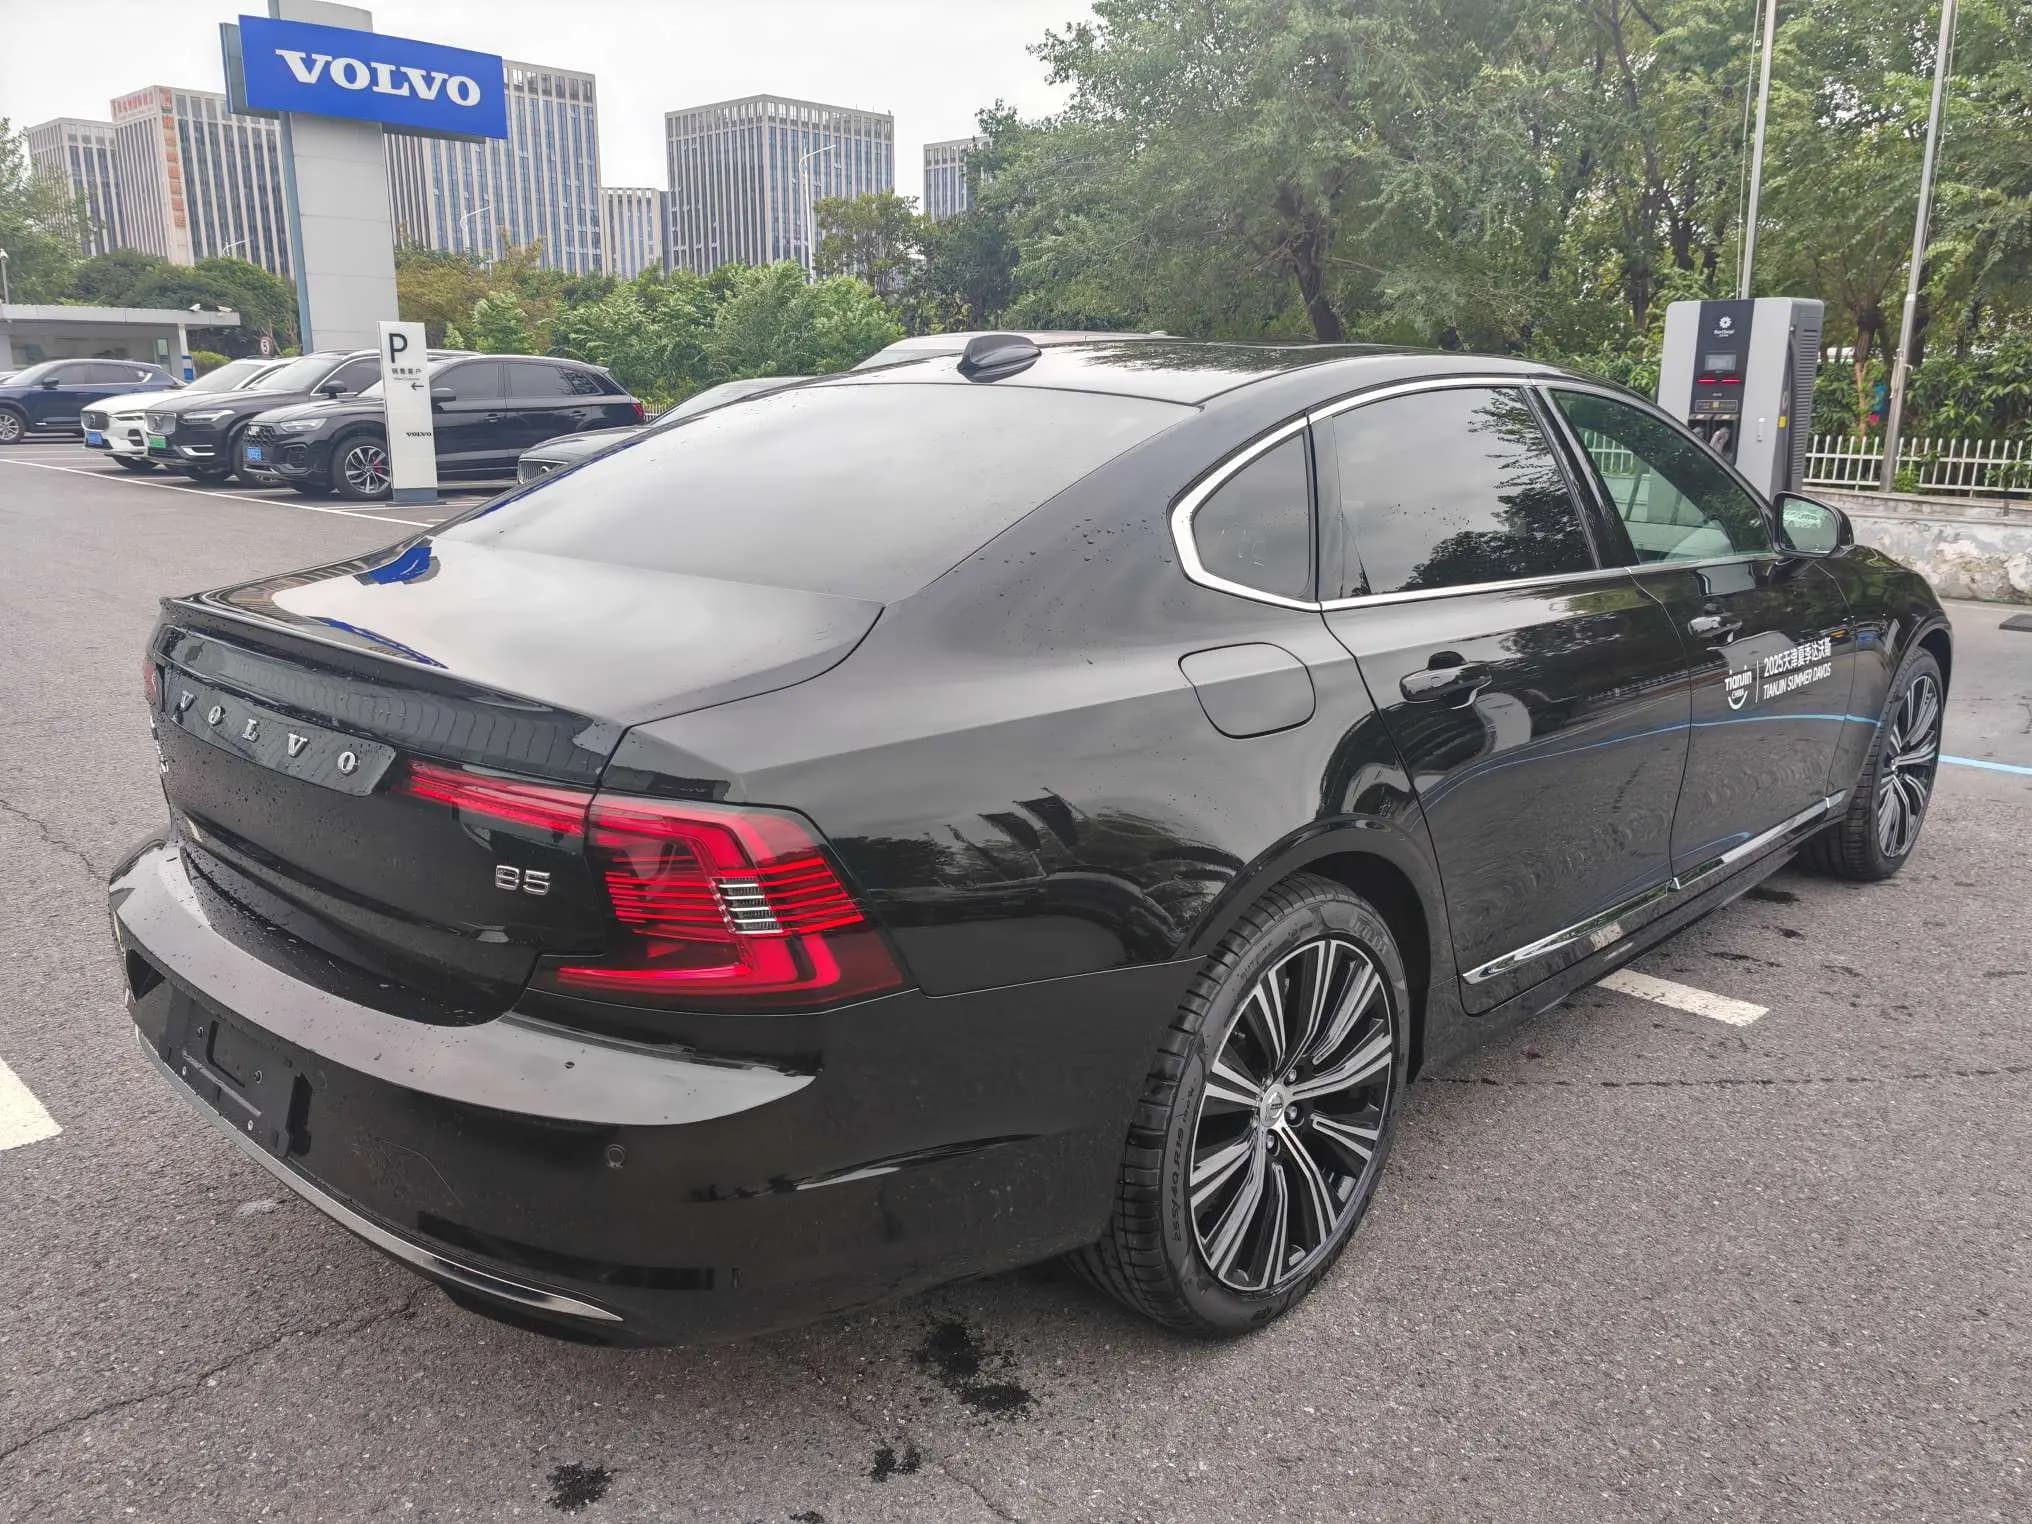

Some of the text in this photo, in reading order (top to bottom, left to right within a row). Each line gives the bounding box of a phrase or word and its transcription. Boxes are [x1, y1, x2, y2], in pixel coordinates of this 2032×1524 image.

[275, 49, 481, 107] VOLVO
[389, 333, 408, 363] P
[1762, 662, 1832, 700] TIANJIN SUMMER DAVOS
[180, 690, 358, 775] VOLVO
[495, 864, 550, 896] B5
